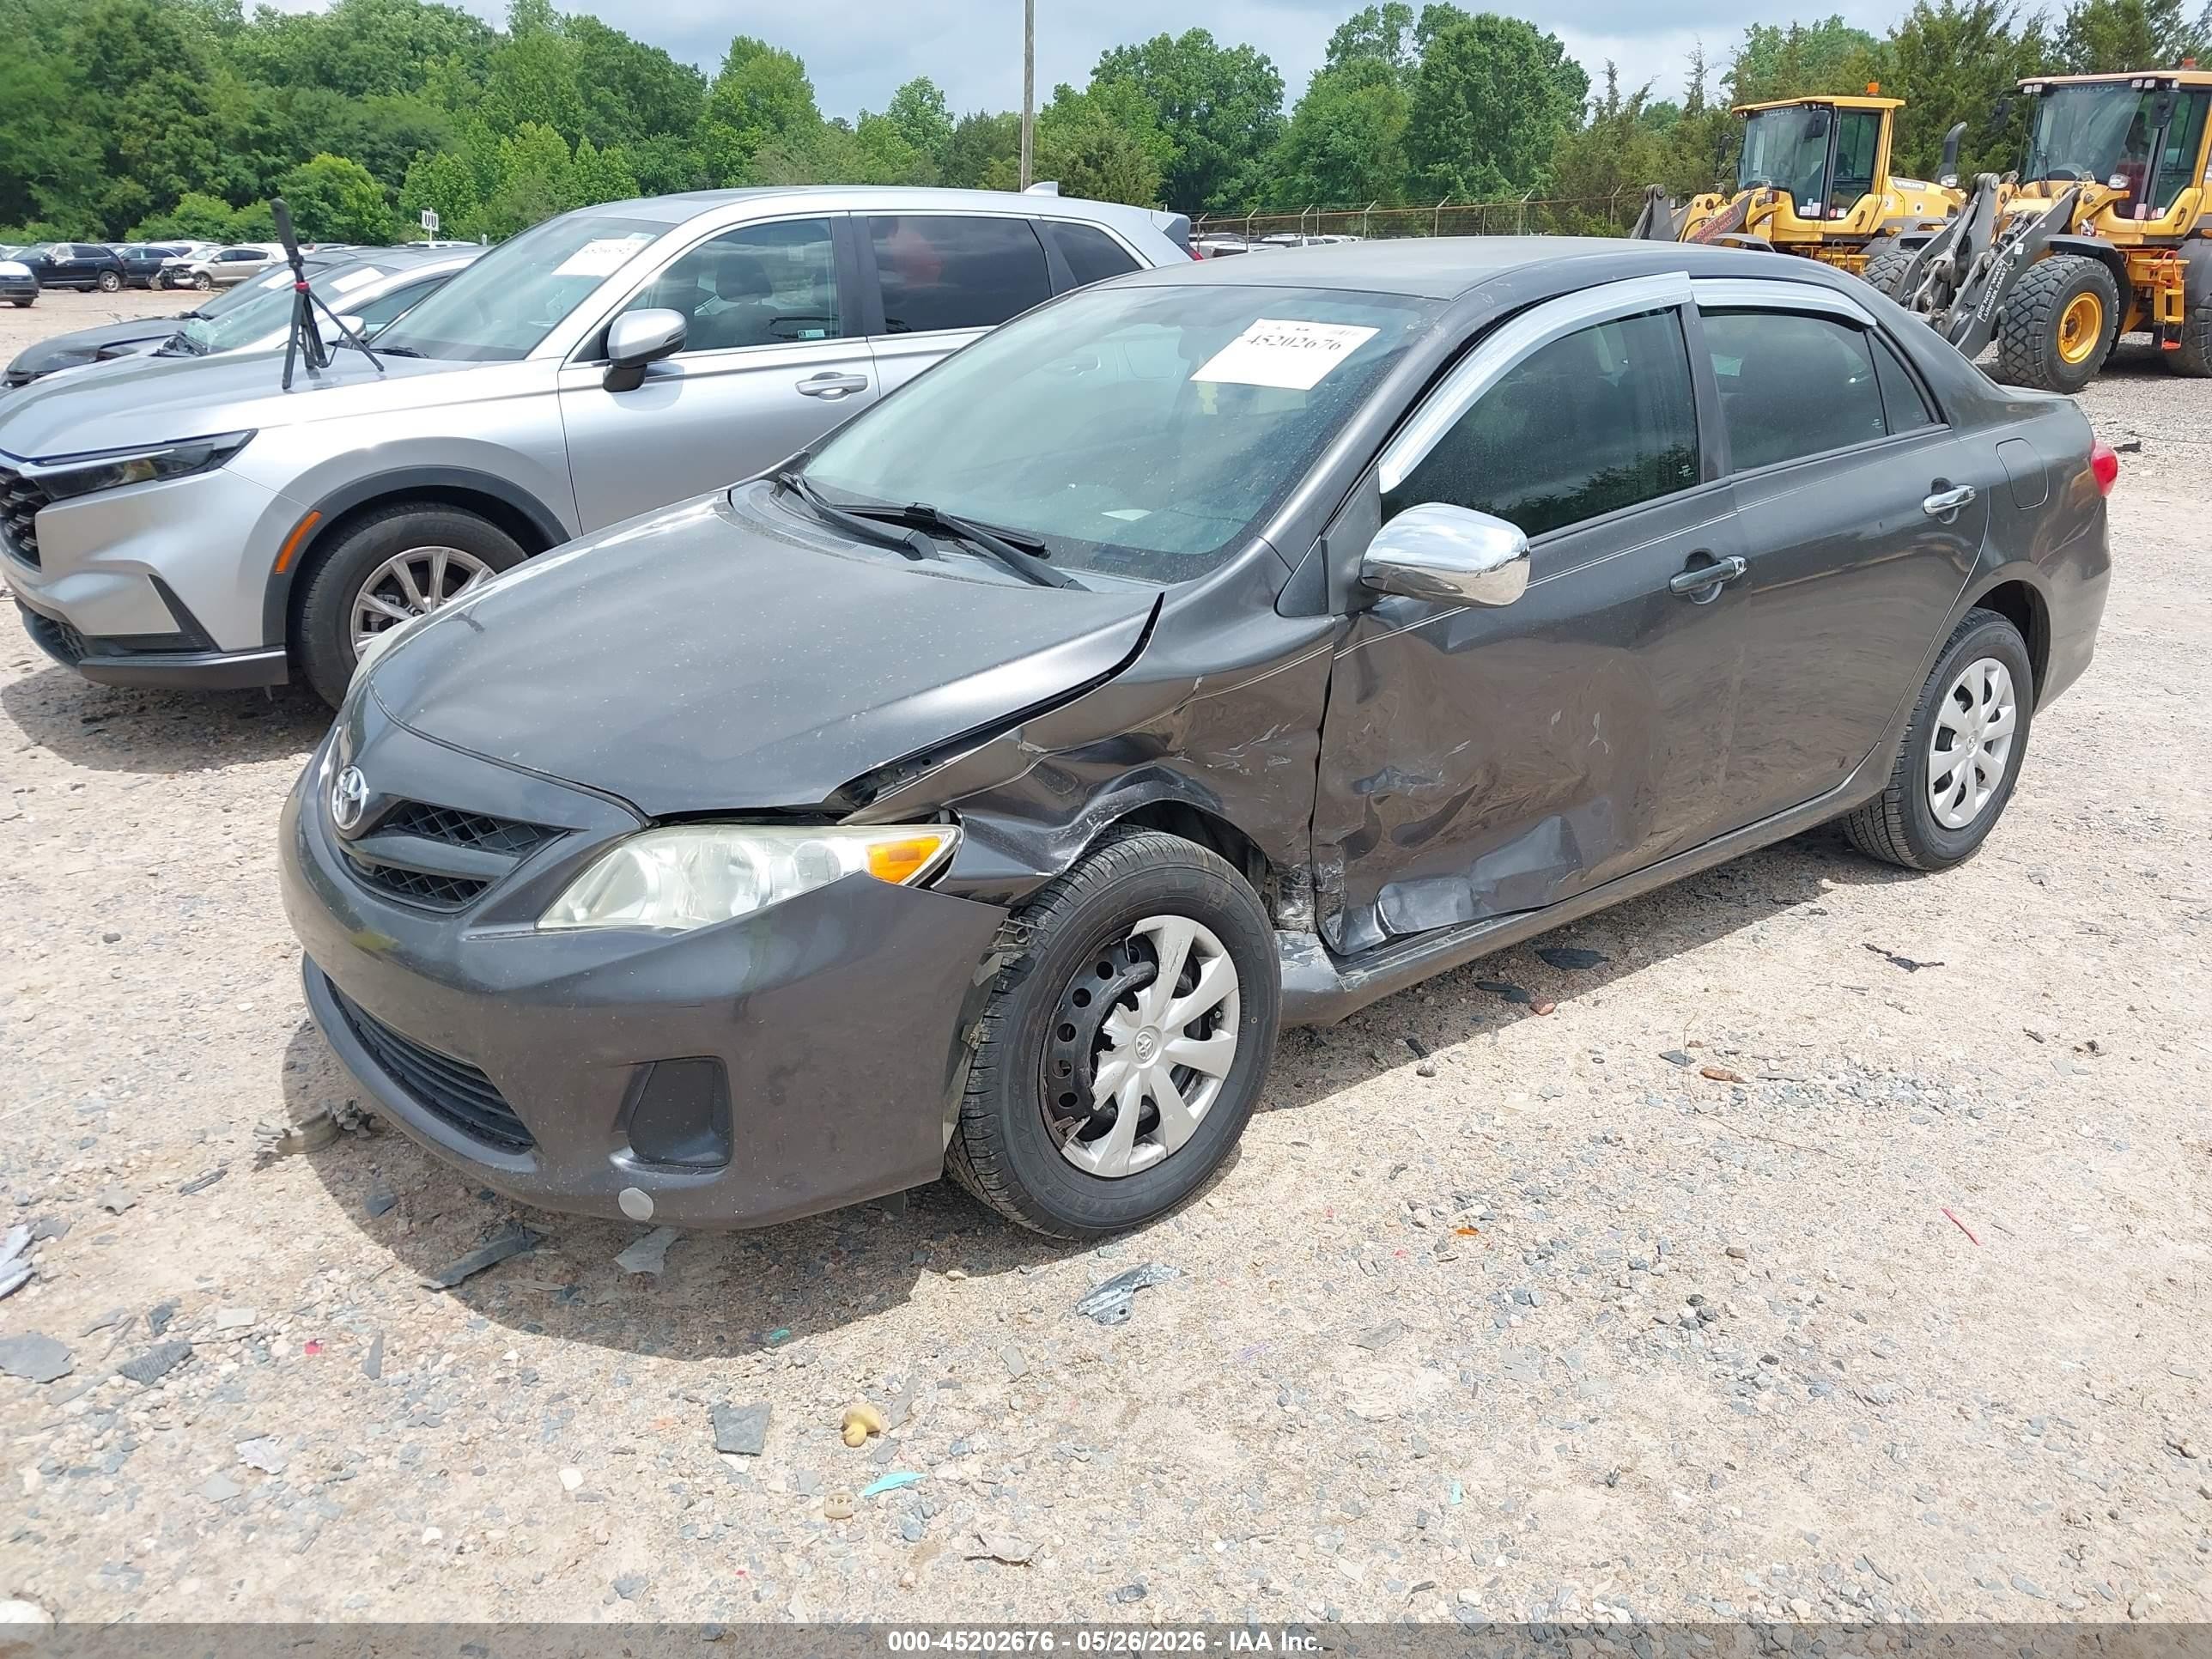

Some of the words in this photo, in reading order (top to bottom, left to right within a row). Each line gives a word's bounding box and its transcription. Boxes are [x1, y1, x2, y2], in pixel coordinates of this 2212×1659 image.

[1894, 179, 1925, 189] VOLVO
[1705, 221, 1717, 234] NOT
[1717, 210, 1733, 223] WALK
[1978, 305, 1984, 319] DO
[1984, 285, 1993, 304] NOT
[1992, 260, 2004, 284] WALK
[1984, 289, 1999, 317] UNDER
[1996, 266, 2008, 290] MAST
